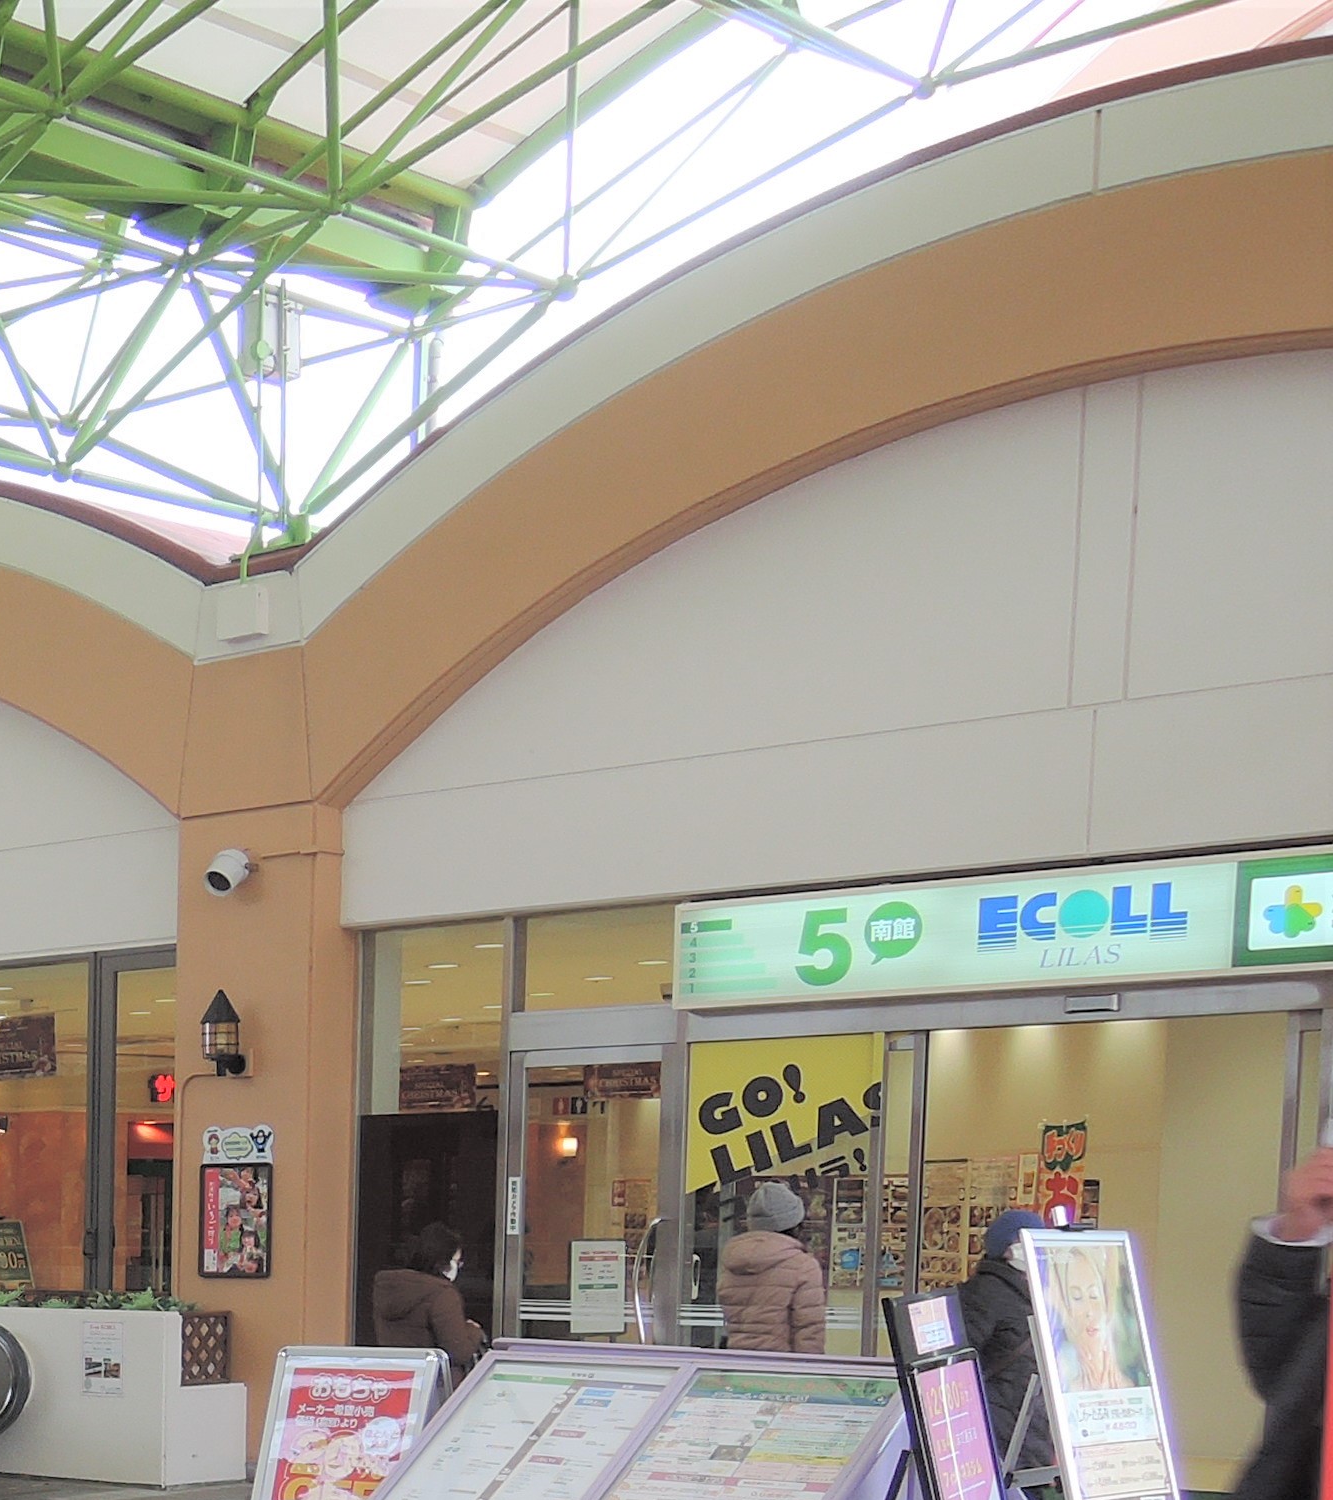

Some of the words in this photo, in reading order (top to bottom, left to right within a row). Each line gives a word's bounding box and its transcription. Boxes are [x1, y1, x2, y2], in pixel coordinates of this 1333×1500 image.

[689, 921, 698, 933] 5
[871, 917, 916, 942] 南館
[977, 882, 1188, 952] ECOLL
[689, 937, 697, 947] 4
[795, 908, 852, 986] 5
[689, 952, 697, 963] 3
[1039, 944, 1121, 969] LILAS
[689, 968, 696, 978] 2
[699, 1064, 806, 1135] GO!
[311, 1374, 390, 1402] おもちゃ
